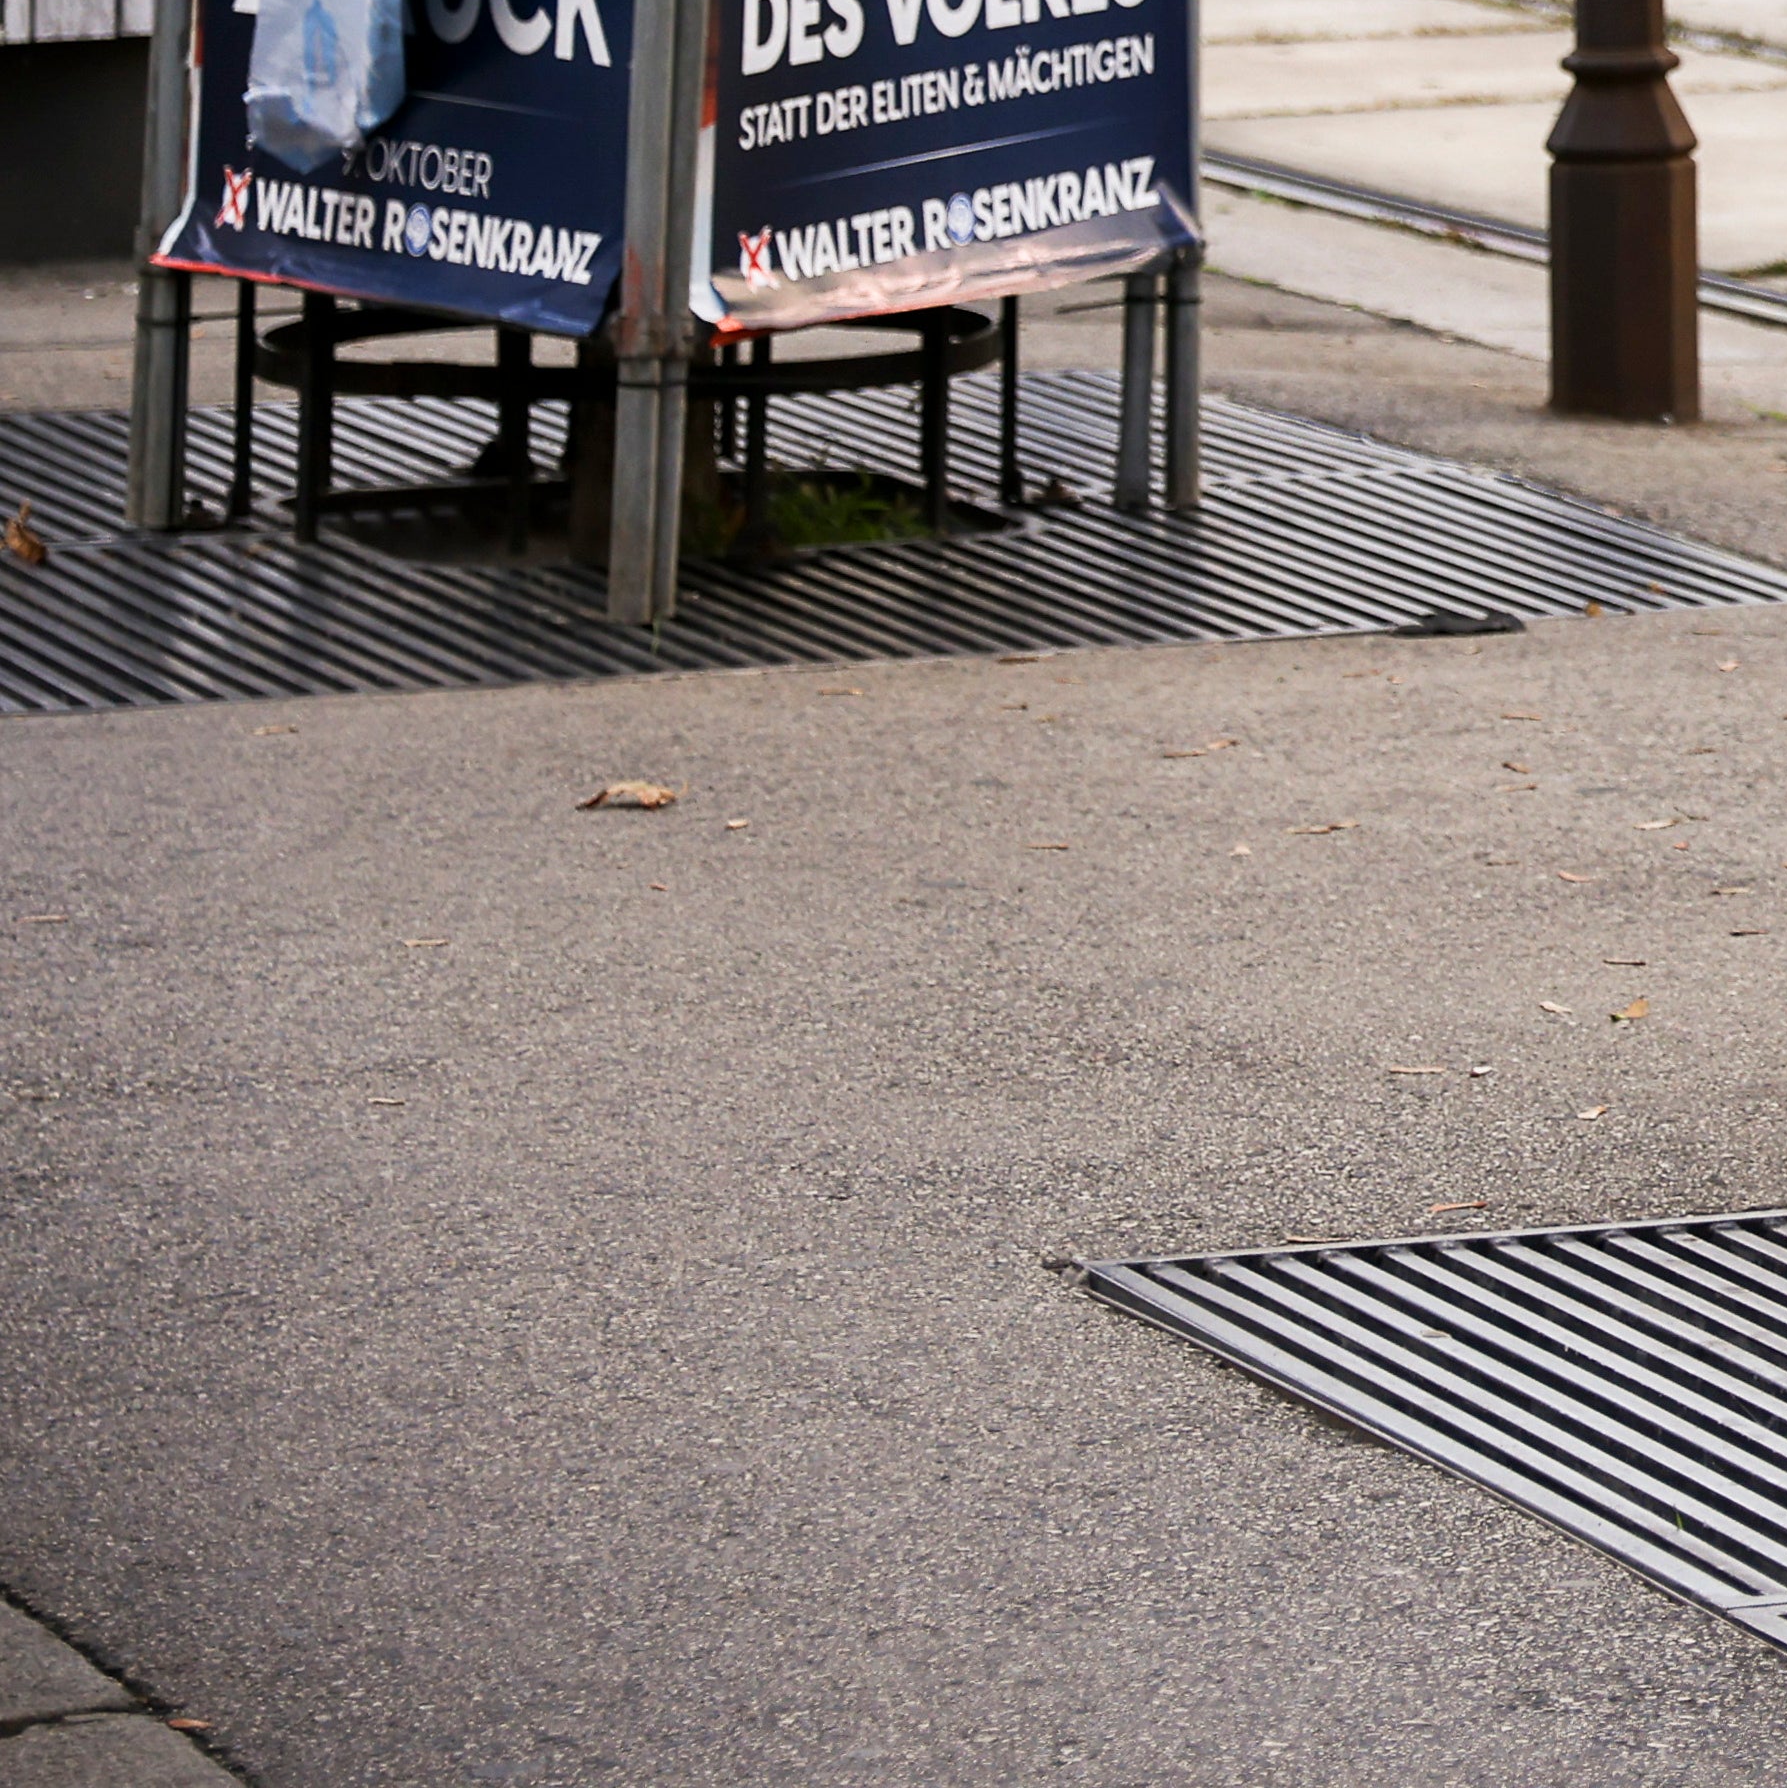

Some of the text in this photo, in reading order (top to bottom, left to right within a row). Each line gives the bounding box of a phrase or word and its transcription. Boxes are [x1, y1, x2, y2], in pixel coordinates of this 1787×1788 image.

[738, 32, 1155, 151] STATT DER ELITEN & MÄCHTIGEN
[365, 137, 494, 200] OKTOBER
[775, 154, 1162, 282] WALTER ROSENKRANZ
[255, 176, 602, 285] WALTER ROSENKRANZ
